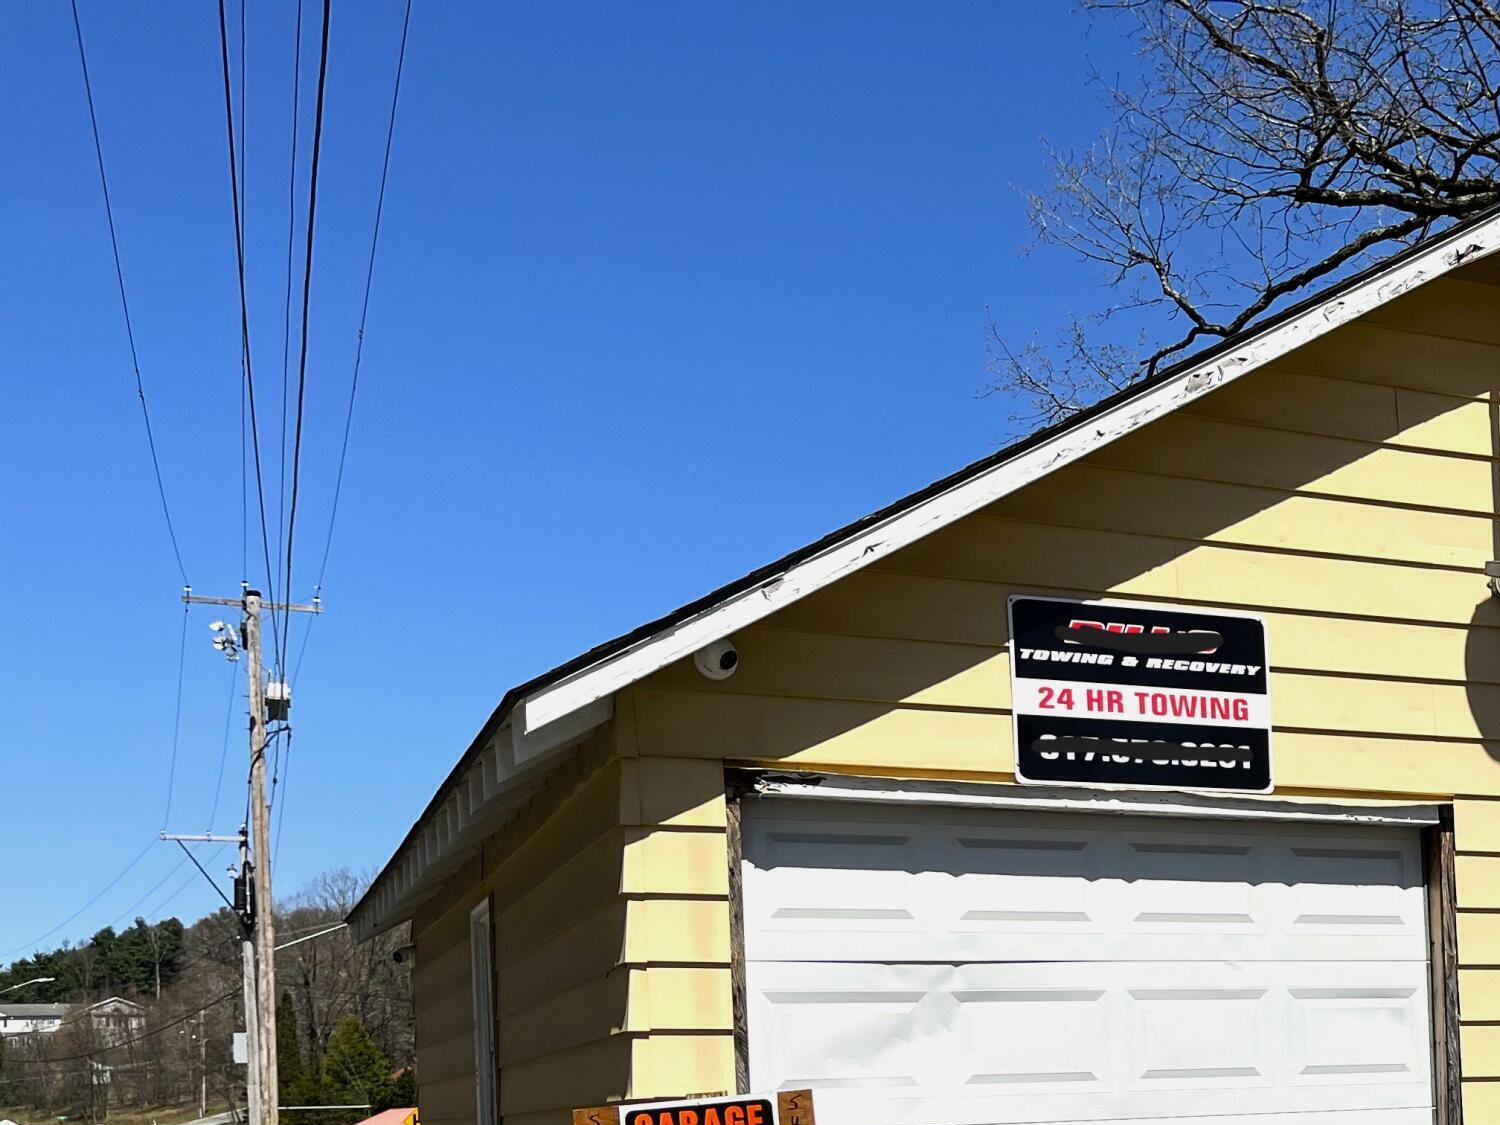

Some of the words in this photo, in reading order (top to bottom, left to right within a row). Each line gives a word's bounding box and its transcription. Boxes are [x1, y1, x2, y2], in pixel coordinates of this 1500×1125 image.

[1019, 648, 1114, 666] TOWING
[1121, 656, 1139, 667] &
[1145, 657, 1262, 676] RECOVERY
[1037, 686, 1075, 710] 24
[1086, 688, 1124, 713] HR
[1133, 691, 1249, 721] TOWING
